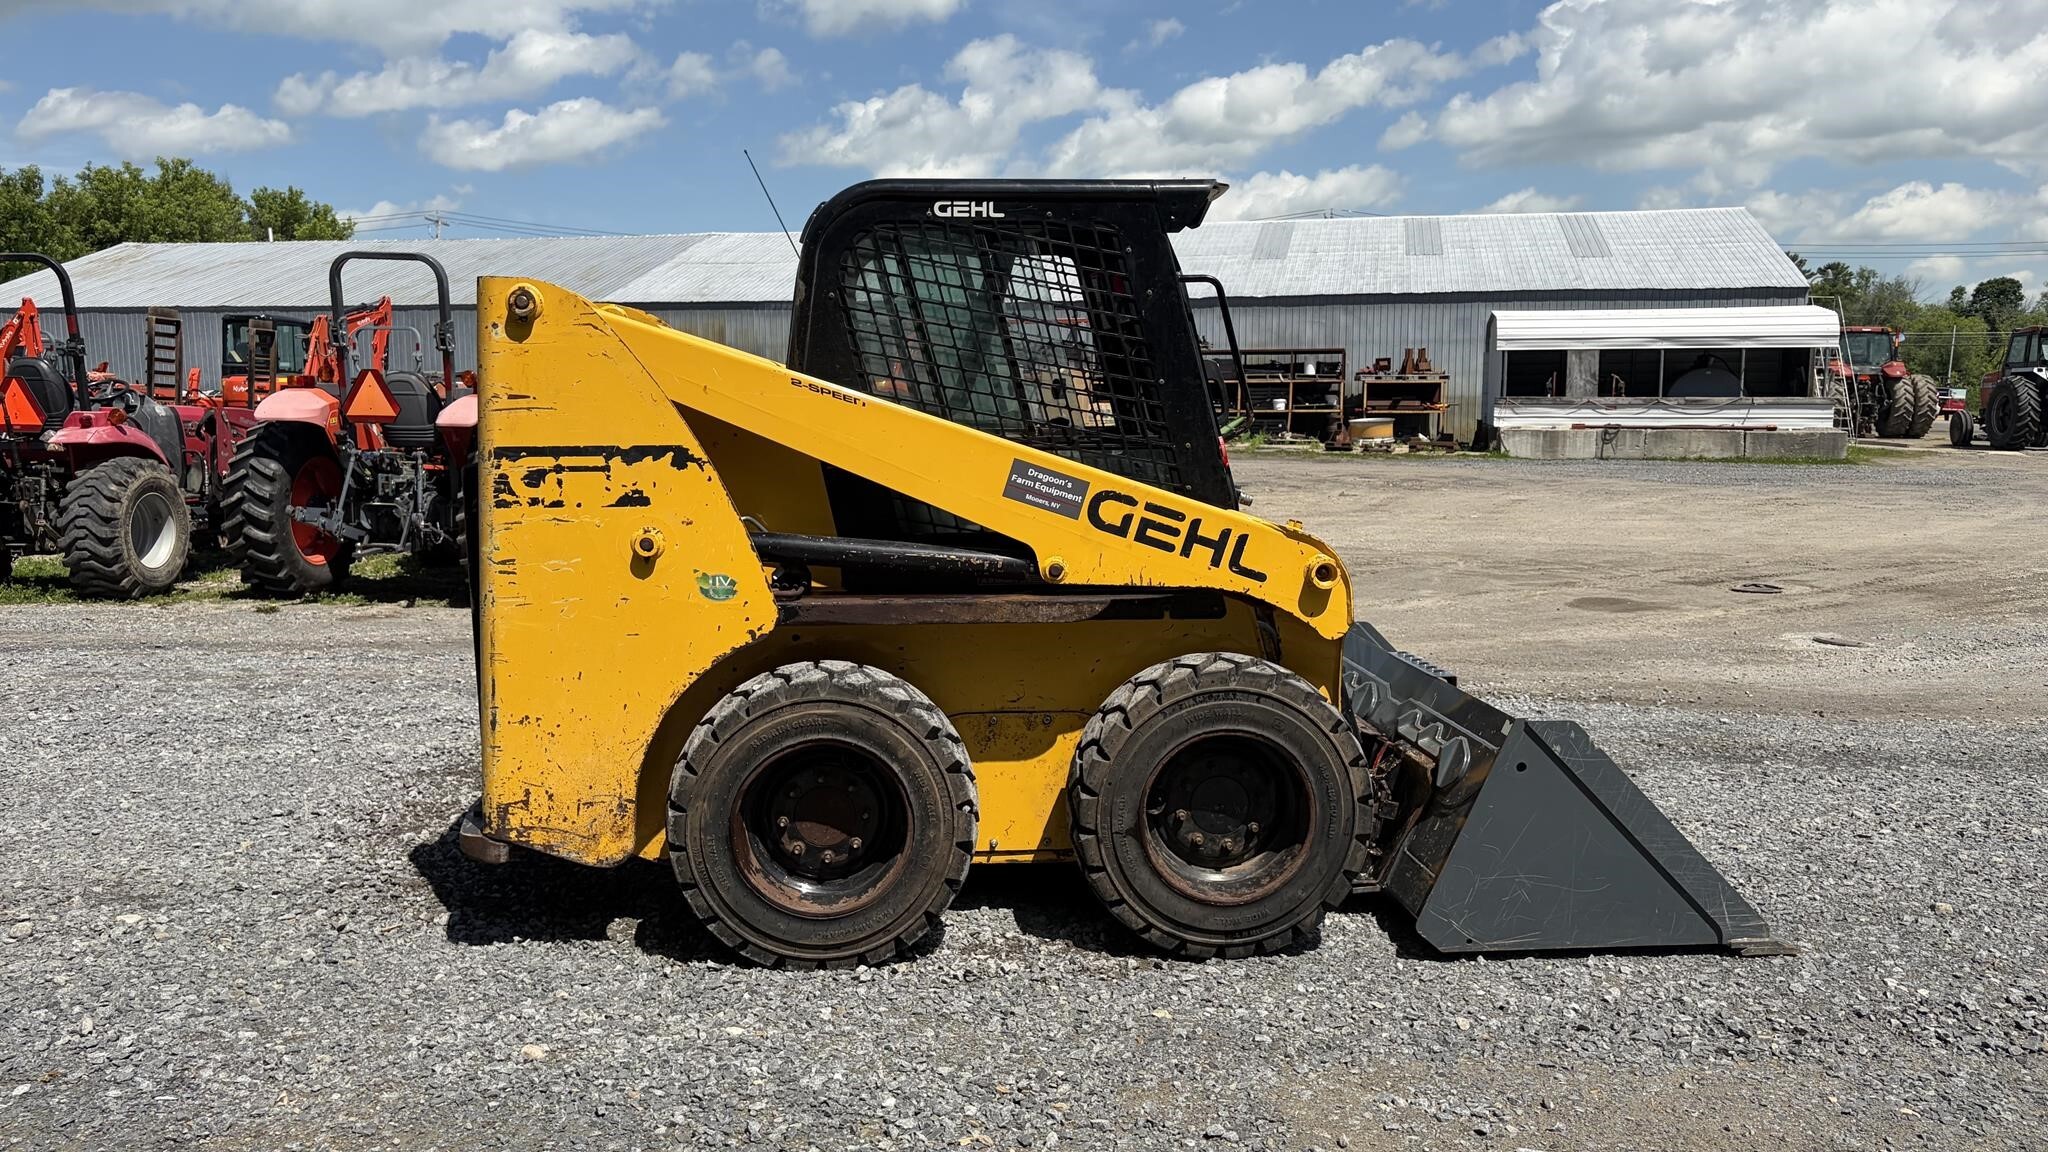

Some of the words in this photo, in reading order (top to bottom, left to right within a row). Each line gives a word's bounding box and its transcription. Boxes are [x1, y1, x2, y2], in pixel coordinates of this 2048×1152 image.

[934, 201, 1005, 218] GEHL
[1011, 474, 1034, 488] Farm
[1034, 482, 1083, 503] Equipment
[1027, 468, 1073, 489] Dragoon's
[1025, 493, 1050, 507] Mooers,
[1050, 501, 1061, 510] NY
[1087, 490, 1267, 583] GEHL
